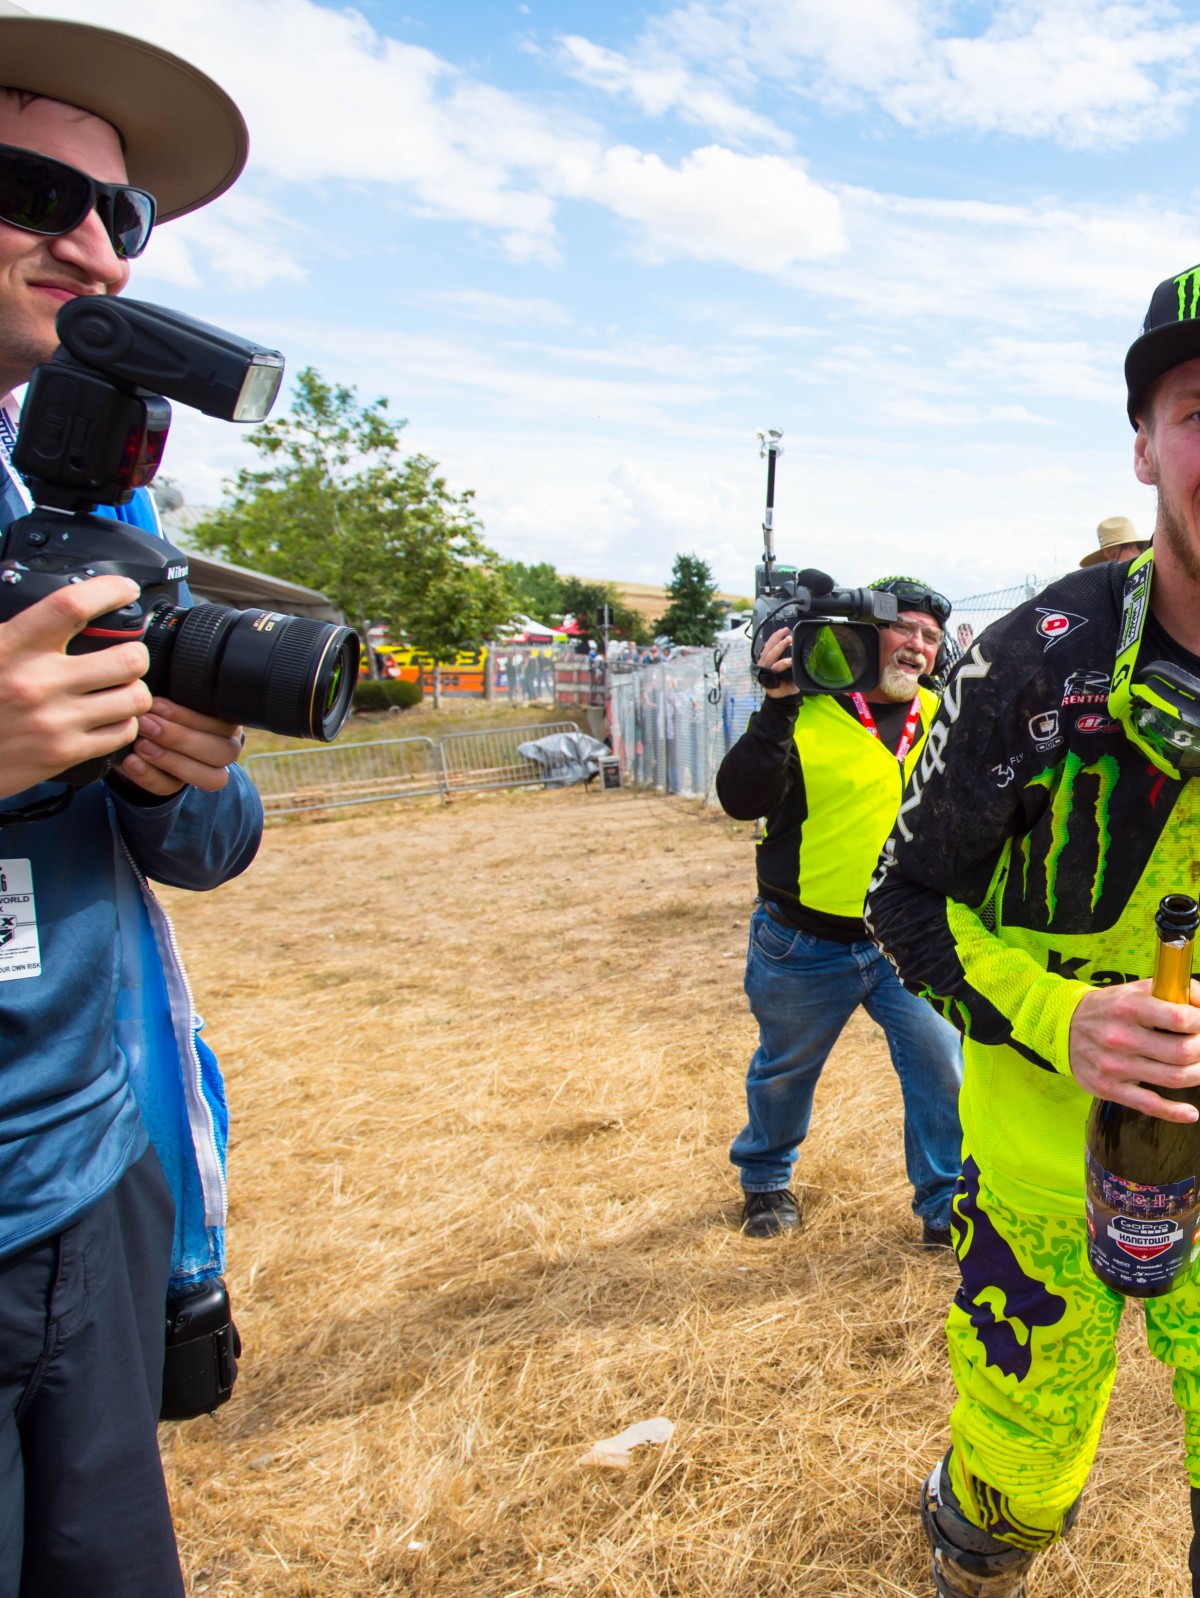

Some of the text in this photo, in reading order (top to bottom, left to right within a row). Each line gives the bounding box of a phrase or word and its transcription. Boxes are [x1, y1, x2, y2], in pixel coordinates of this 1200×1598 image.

[1061, 694, 1110, 706] RENTH
[12, 963, 26, 972] OWN
[27, 962, 41, 970] RISK
[1120, 1219, 1169, 1231] GoPro
[1119, 1233, 1170, 1245] HANGTOWN
